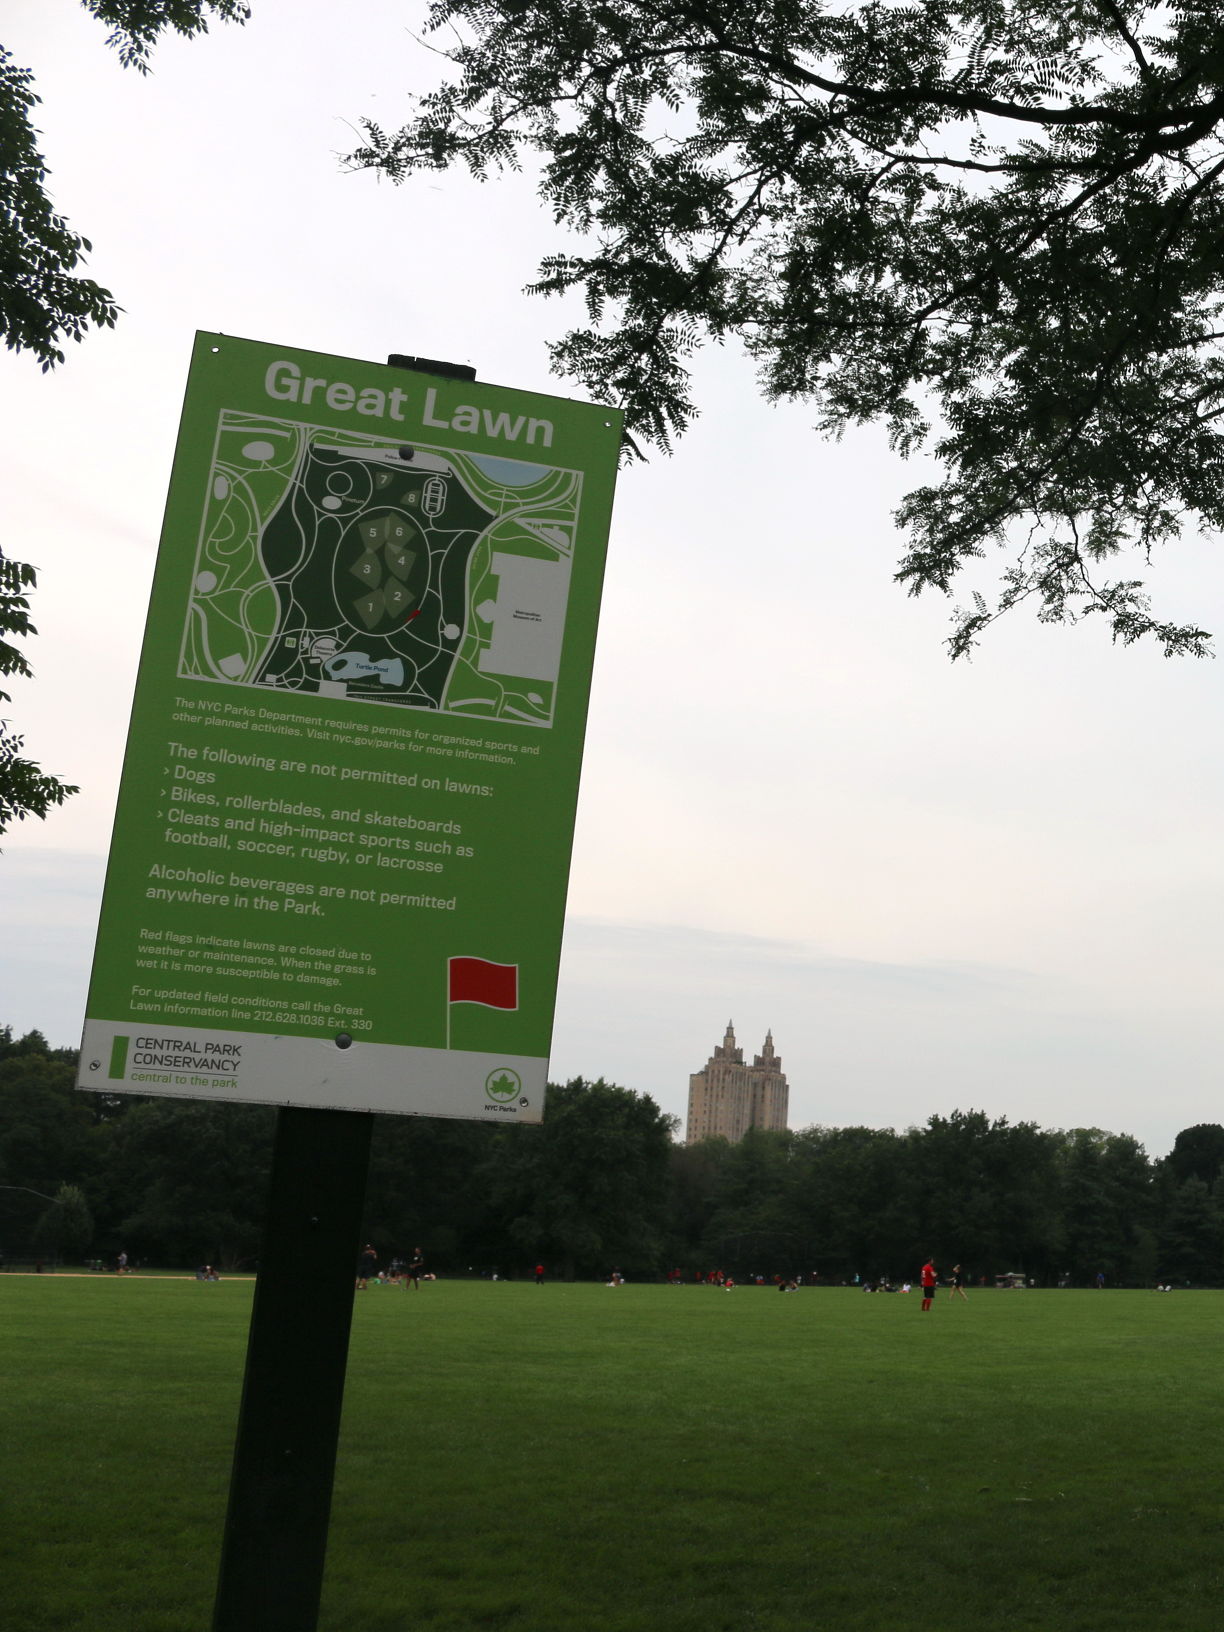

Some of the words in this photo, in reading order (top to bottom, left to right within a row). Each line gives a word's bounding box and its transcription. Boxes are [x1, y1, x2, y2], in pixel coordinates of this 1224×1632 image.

[264, 359, 408, 421] Great
[421, 386, 554, 447] Lawn
[380, 475, 388, 484] 7
[408, 494, 415, 503] 8
[369, 528, 377, 537] 5
[395, 527, 403, 536] 6
[363, 565, 371, 574] 3
[398, 556, 406, 566] 4
[394, 592, 402, 601] 2
[171, 711, 203, 723] other
[203, 715, 249, 729] planned
[250, 722, 303, 736] activities.
[306, 727, 330, 740] Visit
[331, 733, 406, 750] nyc.gov/parks
[407, 740, 424, 752] for
[425, 745, 453, 756] more
[454, 748, 516, 765] information.
[174, 696, 195, 709] The
[196, 699, 222, 712] NYC
[223, 702, 256, 717] Parks
[257, 707, 322, 726] Department
[324, 718, 369, 732] requires
[370, 725, 412, 738] permits
[413, 728, 430, 739] for
[431, 733, 483, 747] organized
[483, 740, 518, 752] sports
[519, 745, 540, 755] and
[167, 741, 198, 759] The
[201, 745, 277, 771] following
[279, 759, 307, 773] are
[310, 763, 337, 777] not
[340, 767, 418, 787] permitted
[420, 777, 440, 790] on
[444, 776, 493, 796] lawns:
[173, 764, 216, 784] Dogs
[170, 785, 220, 807] Bikes,
[224, 794, 325, 820] rollerblades,
[329, 808, 361, 822] and
[363, 810, 461, 835] skateboards
[167, 807, 220, 827] Cleats
[223, 817, 255, 832] and
[258, 817, 355, 843] high-impact
[358, 833, 410, 850] sports
[413, 839, 452, 855] such
[455, 845, 474, 857] as
[164, 827, 231, 850] football,
[236, 839, 295, 857] soccer,
[300, 846, 350, 864] rugby,
[354, 853, 373, 864] or
[376, 851, 443, 873] lacrosse
[145, 886, 230, 906] anywhere
[233, 893, 248, 908] in
[252, 895, 279, 911] the
[283, 897, 325, 916] Park.
[147, 863, 225, 885] Alcoholic
[228, 871, 314, 895] beverages
[318, 885, 346, 898] are
[349, 888, 376, 902] not
[379, 892, 456, 910] permitted
[139, 927, 163, 940] Red
[164, 930, 193, 945] flags
[195, 934, 240, 948] indicate
[242, 938, 276, 952] lawns
[277, 944, 297, 954] are
[298, 944, 336, 957] closed
[337, 948, 358, 960] due
[359, 951, 372, 961] to
[135, 958, 158, 968] wet
[159, 959, 168, 969] it
[170, 960, 181, 971] is
[183, 963, 213, 974] more
[215, 966, 280, 980] susceptible
[281, 971, 294, 981] to
[295, 971, 342, 987] damage.
[137, 944, 186, 956] weather
[187, 949, 201, 958] or
[202, 950, 277, 966] maintenance.
[280, 955, 311, 969] When
[313, 959, 332, 971] the
[333, 963, 364, 974] grass
[366, 965, 376, 976] is
[129, 998, 161, 1012] Lawn
[163, 1002, 229, 1017] information
[230, 1007, 251, 1020] line
[252, 1009, 325, 1026] 212.628.1036
[326, 1016, 348, 1028] Ext.
[350, 1018, 373, 1030] 330
[131, 984, 152, 996] For
[153, 988, 201, 1001] updated
[203, 990, 229, 1003] field
[230, 995, 289, 1009] conditions
[290, 1000, 311, 1010] call
[312, 1001, 331, 1013] the
[332, 1002, 364, 1015] Great
[132, 1051, 240, 1071] CONSERVANCY
[135, 1036, 201, 1053] CENTRAL
[203, 1041, 242, 1056] PARK
[130, 1072, 172, 1083] central
[174, 1075, 187, 1084] to
[189, 1075, 209, 1086] the
[211, 1078, 237, 1088] park
